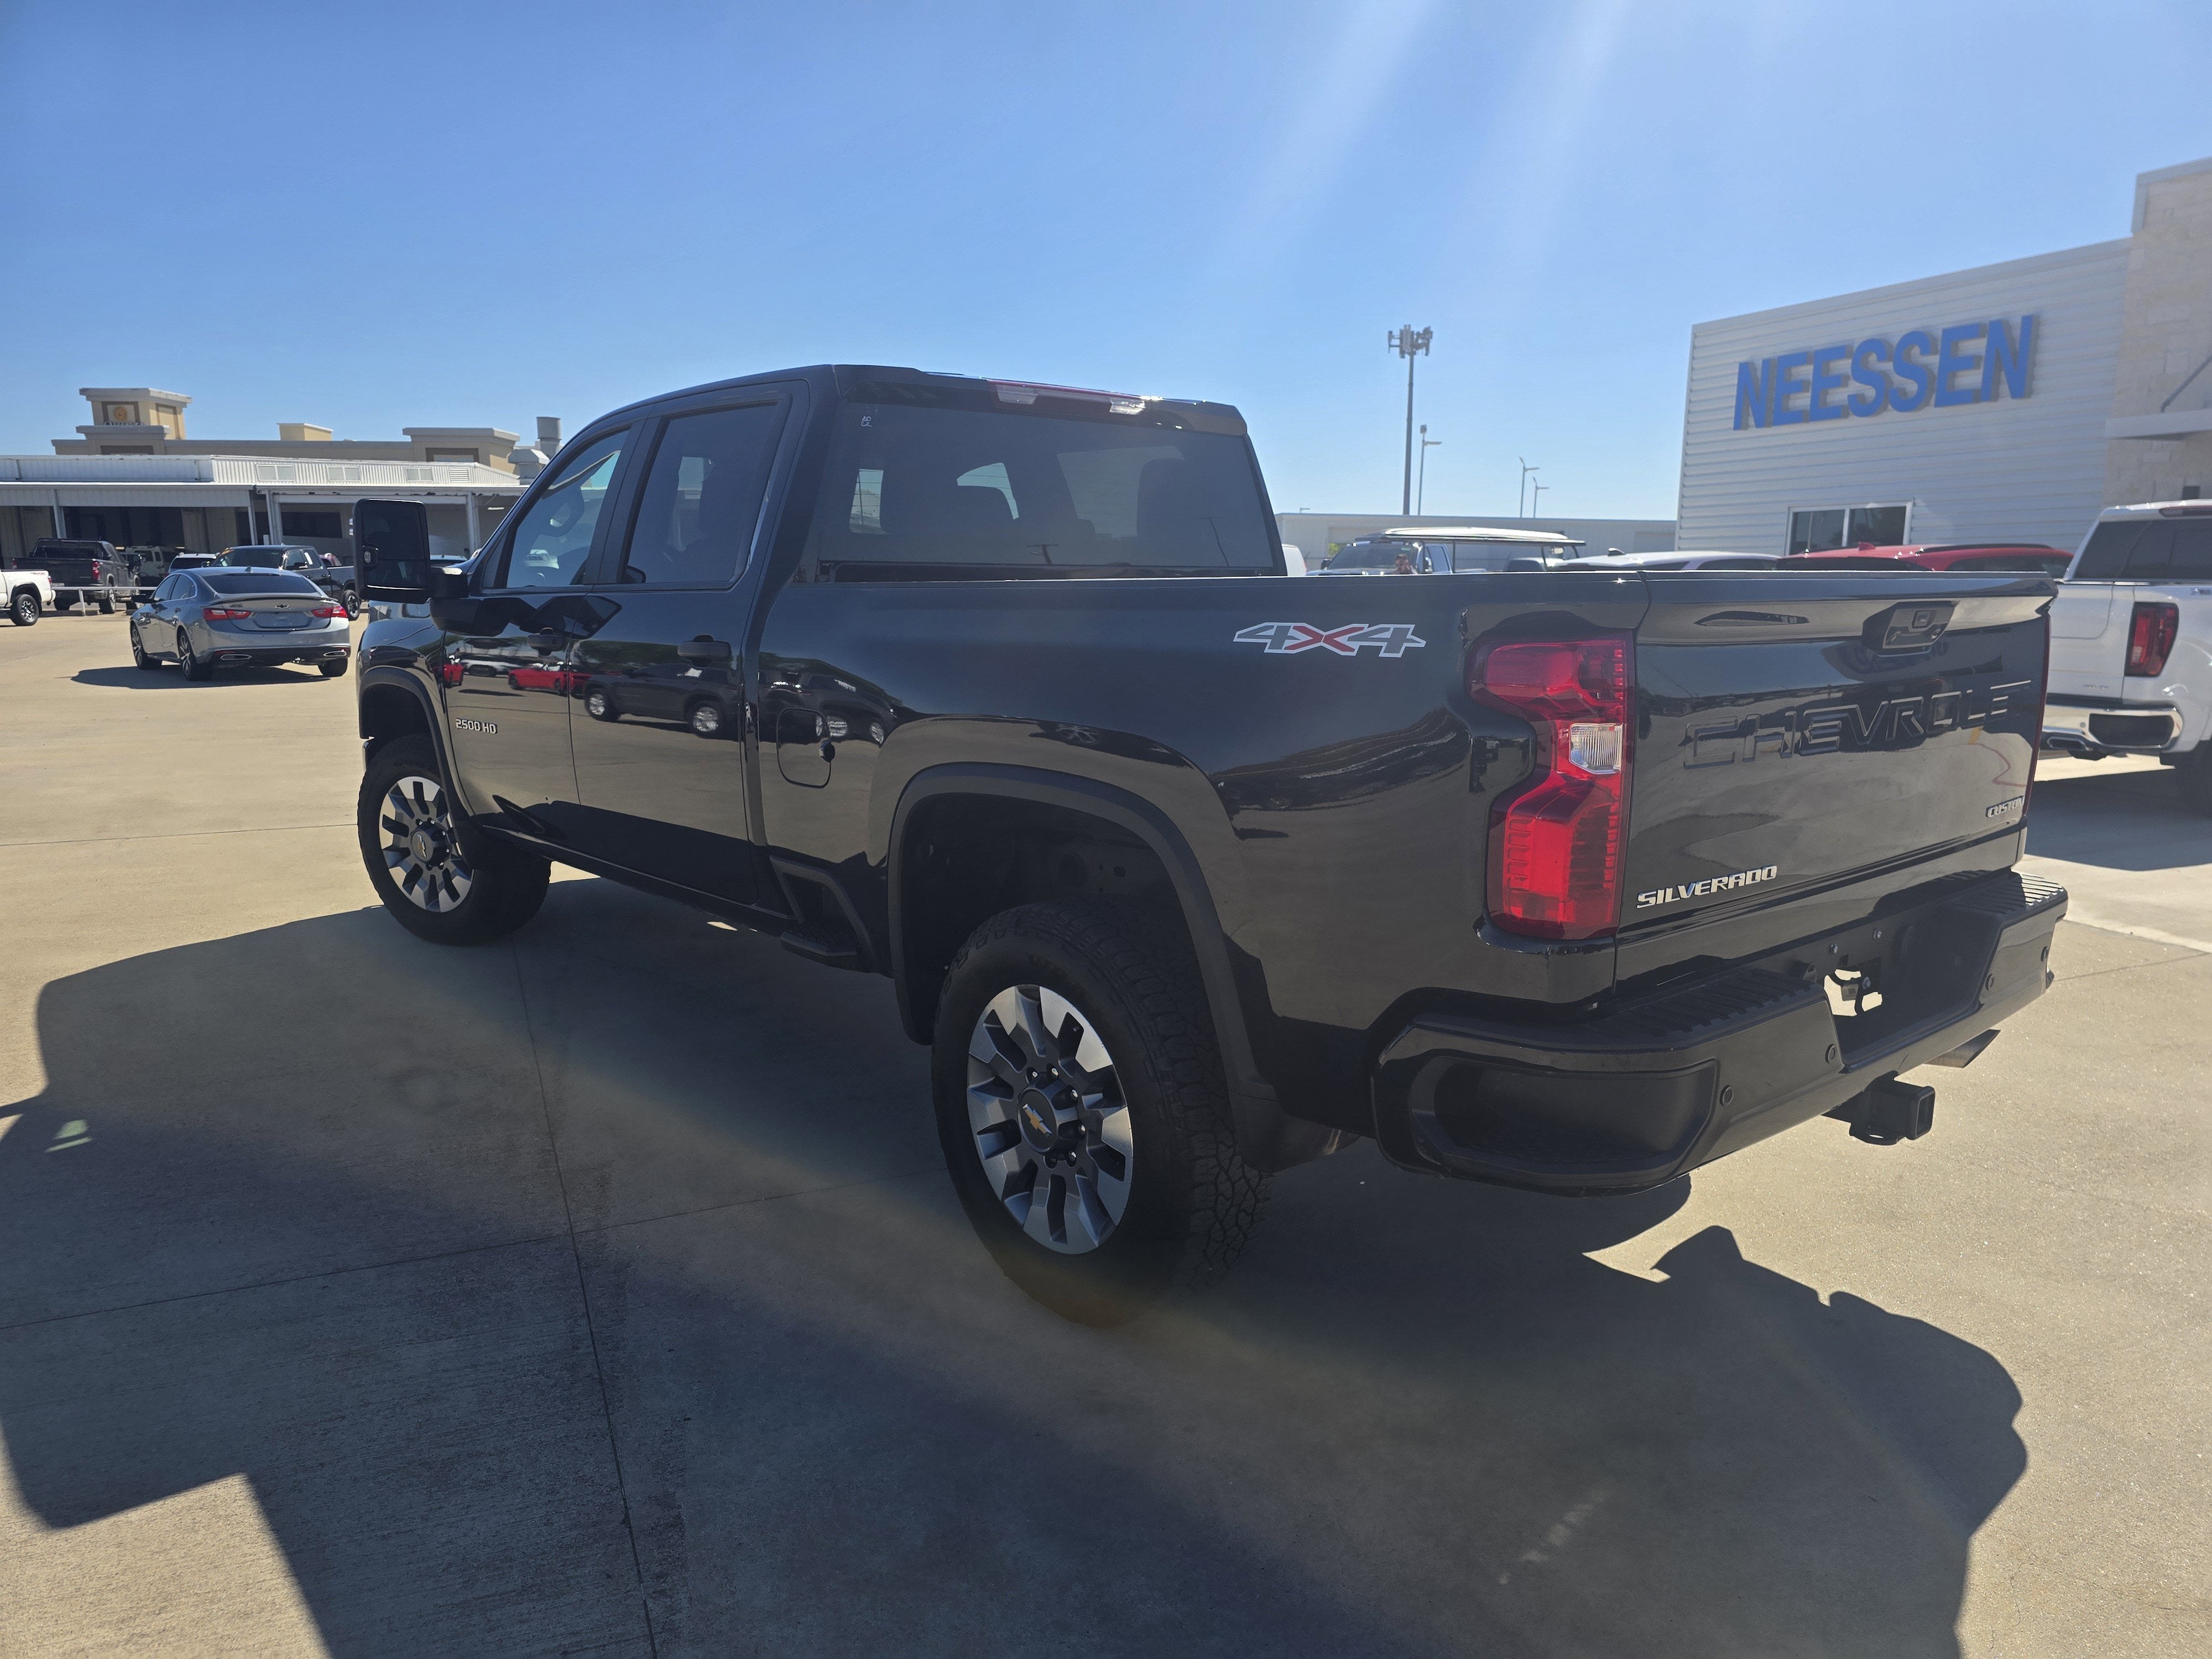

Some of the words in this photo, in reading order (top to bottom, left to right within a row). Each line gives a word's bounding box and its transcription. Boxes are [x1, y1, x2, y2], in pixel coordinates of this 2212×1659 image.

[1733, 315, 2037, 430] NEESSEN
[455, 718, 481, 731] 2500
[482, 722, 497, 734] HD
[1636, 865, 1777, 909] SILVERADO
